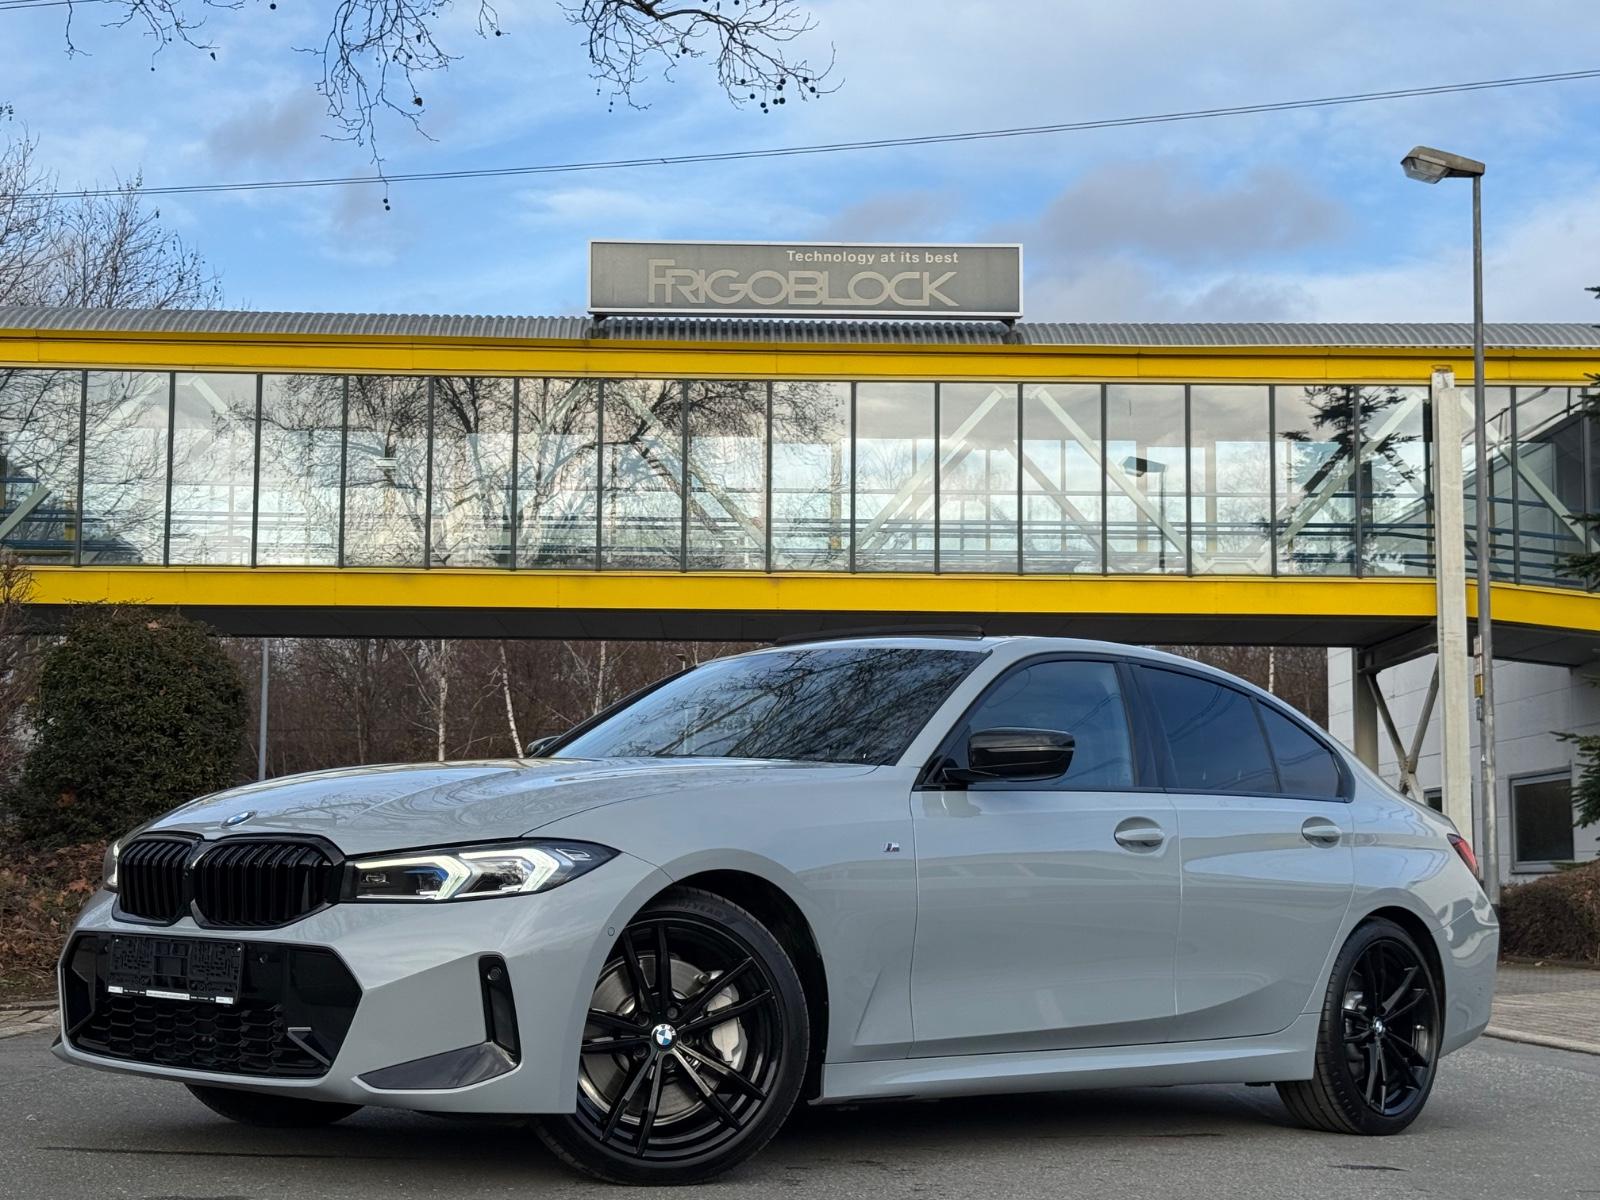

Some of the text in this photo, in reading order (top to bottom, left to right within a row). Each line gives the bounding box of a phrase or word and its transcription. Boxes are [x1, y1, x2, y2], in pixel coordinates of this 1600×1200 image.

[787, 250, 959, 265] Technology at its best
[648, 259, 960, 306] FRIGOBLOCK
